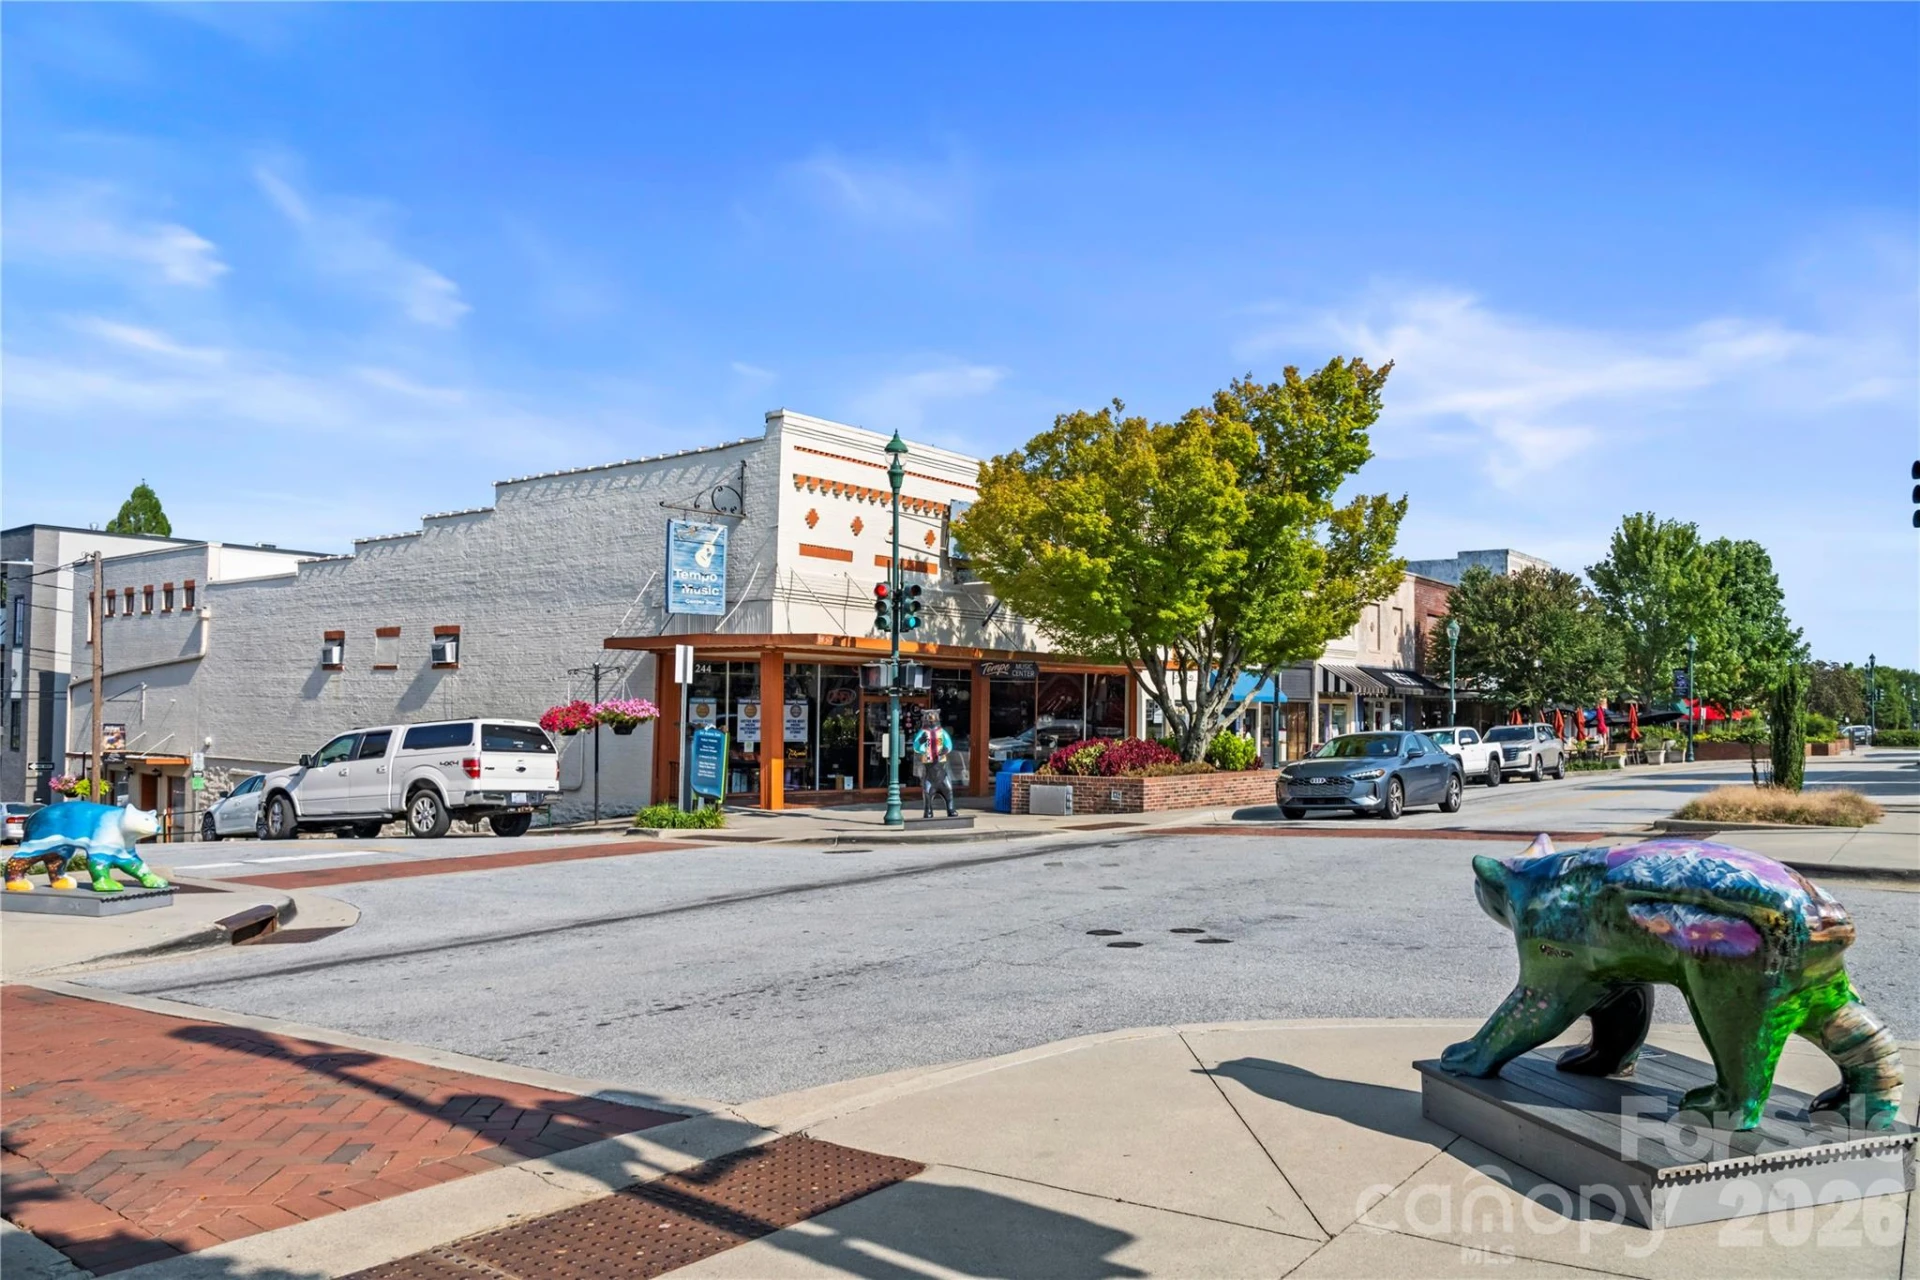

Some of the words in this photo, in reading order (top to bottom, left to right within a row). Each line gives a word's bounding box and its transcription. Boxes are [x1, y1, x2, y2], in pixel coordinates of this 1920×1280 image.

[673, 568, 718, 584] Tempo
[682, 584, 719, 597] Music
[695, 664, 712, 673] 244
[981, 662, 1010, 676] Tempo
